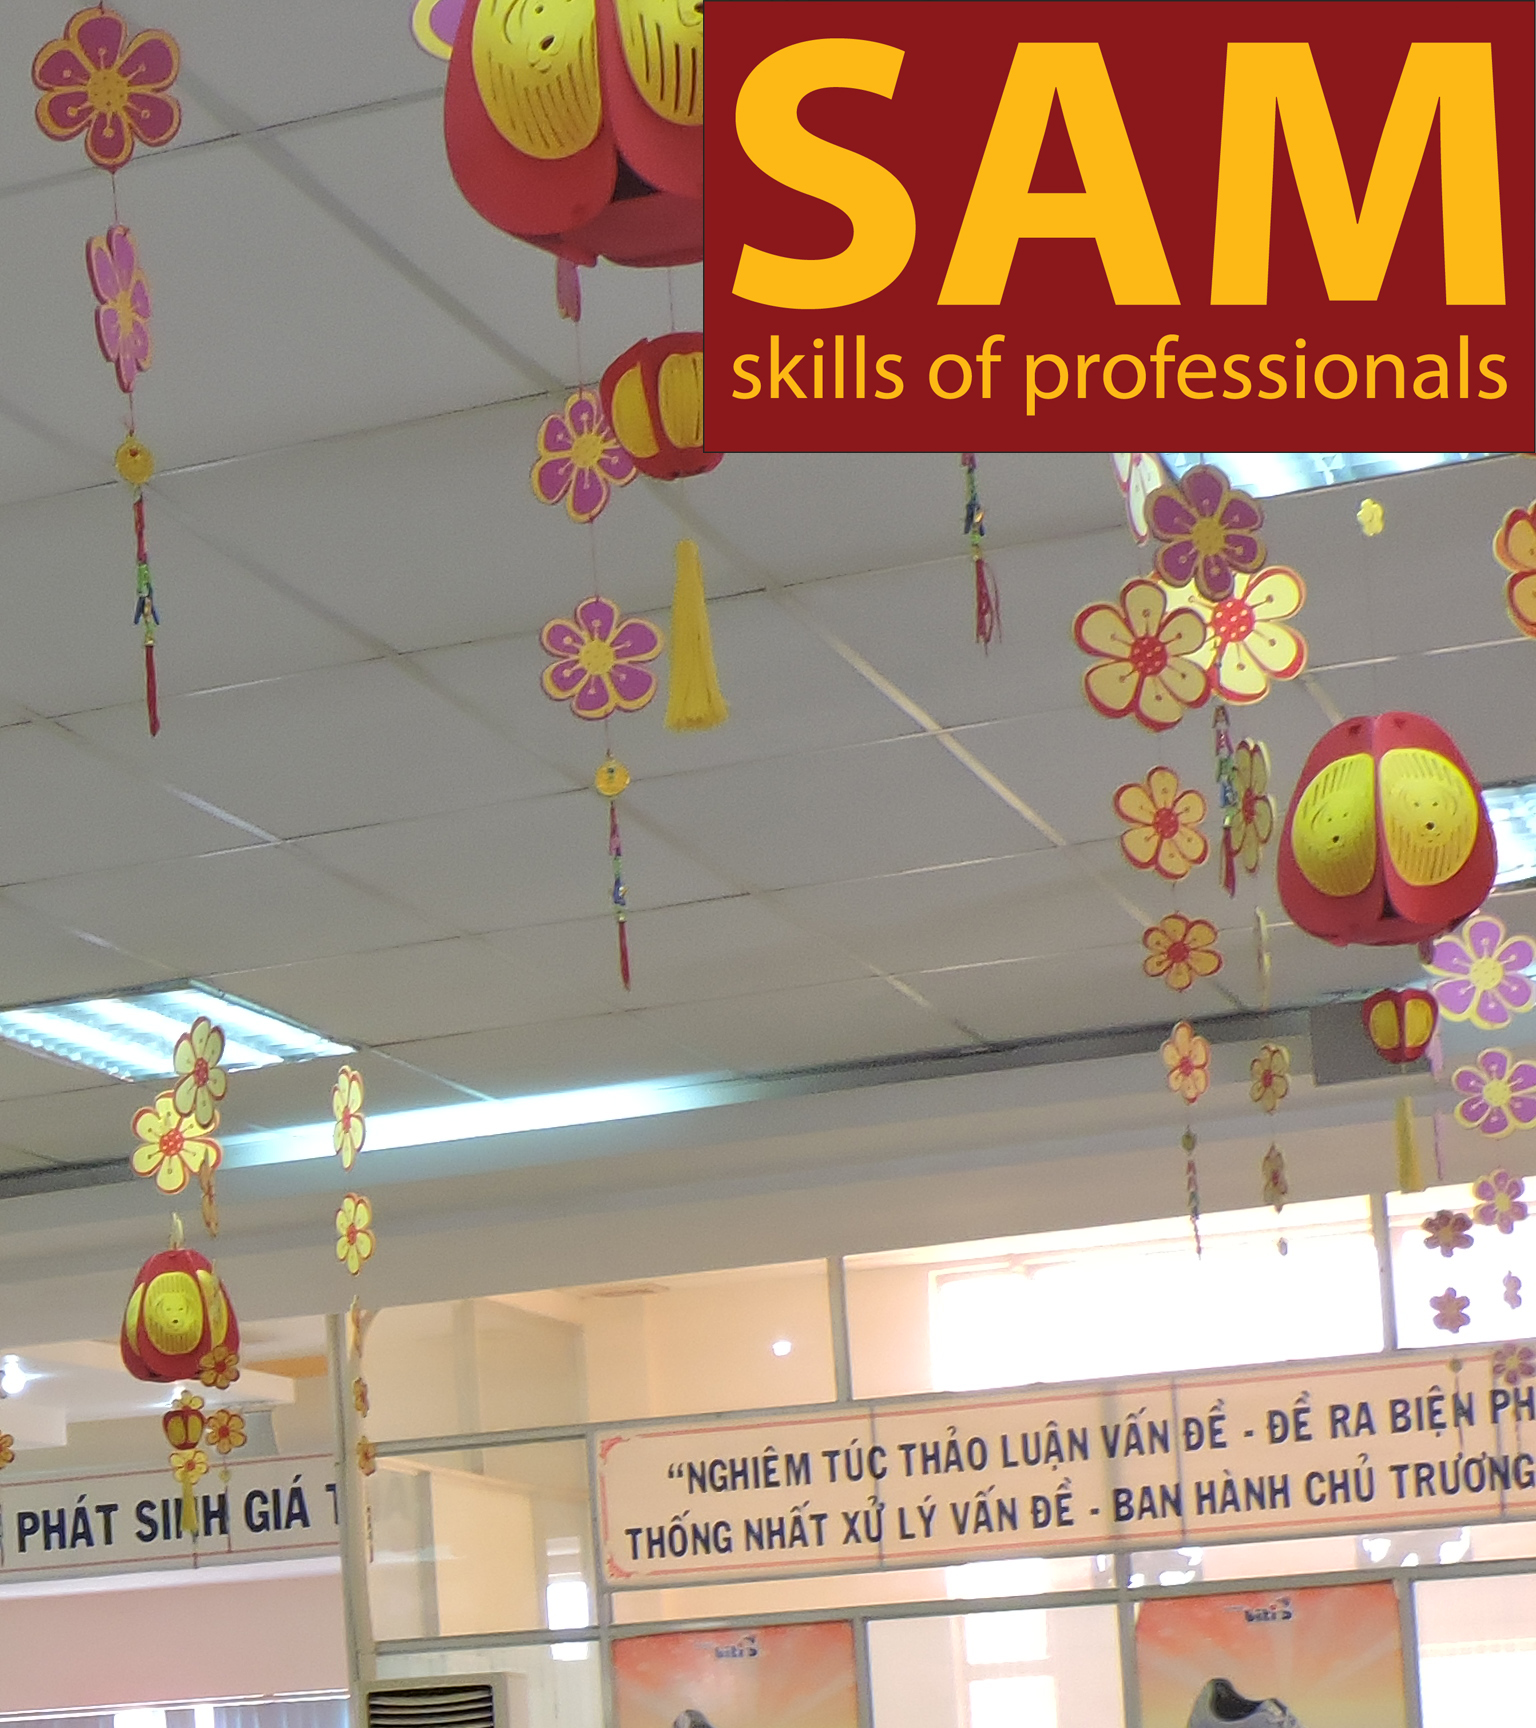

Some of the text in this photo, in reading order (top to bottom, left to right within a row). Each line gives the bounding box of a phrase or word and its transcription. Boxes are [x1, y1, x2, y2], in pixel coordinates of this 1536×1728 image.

[822, 1438, 887, 1482] TÚC
[898, 1426, 988, 1476] THẢO
[1001, 1420, 1088, 1471] LUẬN
[1100, 1407, 1171, 1458] VẤN
[1183, 1398, 1227, 1452] ĐỀ
[1266, 1390, 1313, 1444] ĐỀ
[1328, 1401, 1376, 1439] RA
[1389, 1385, 1475, 1437] BIỆN
[17, 1493, 119, 1553] PHÁT
[244, 1474, 311, 1533] GIÁ
[625, 1509, 733, 1561] THỐNG
[744, 1500, 828, 1551] NHẤT
[841, 1495, 886, 1546] XỬ
[898, 1494, 937, 1541] LÝ
[950, 1484, 1018, 1536] VẤN
[1029, 1476, 1075, 1530] ĐỀ
[1113, 1482, 1184, 1523] BAN
[1195, 1469, 1291, 1516] HÀNH
[1305, 1452, 1375, 1507] CHỦ
